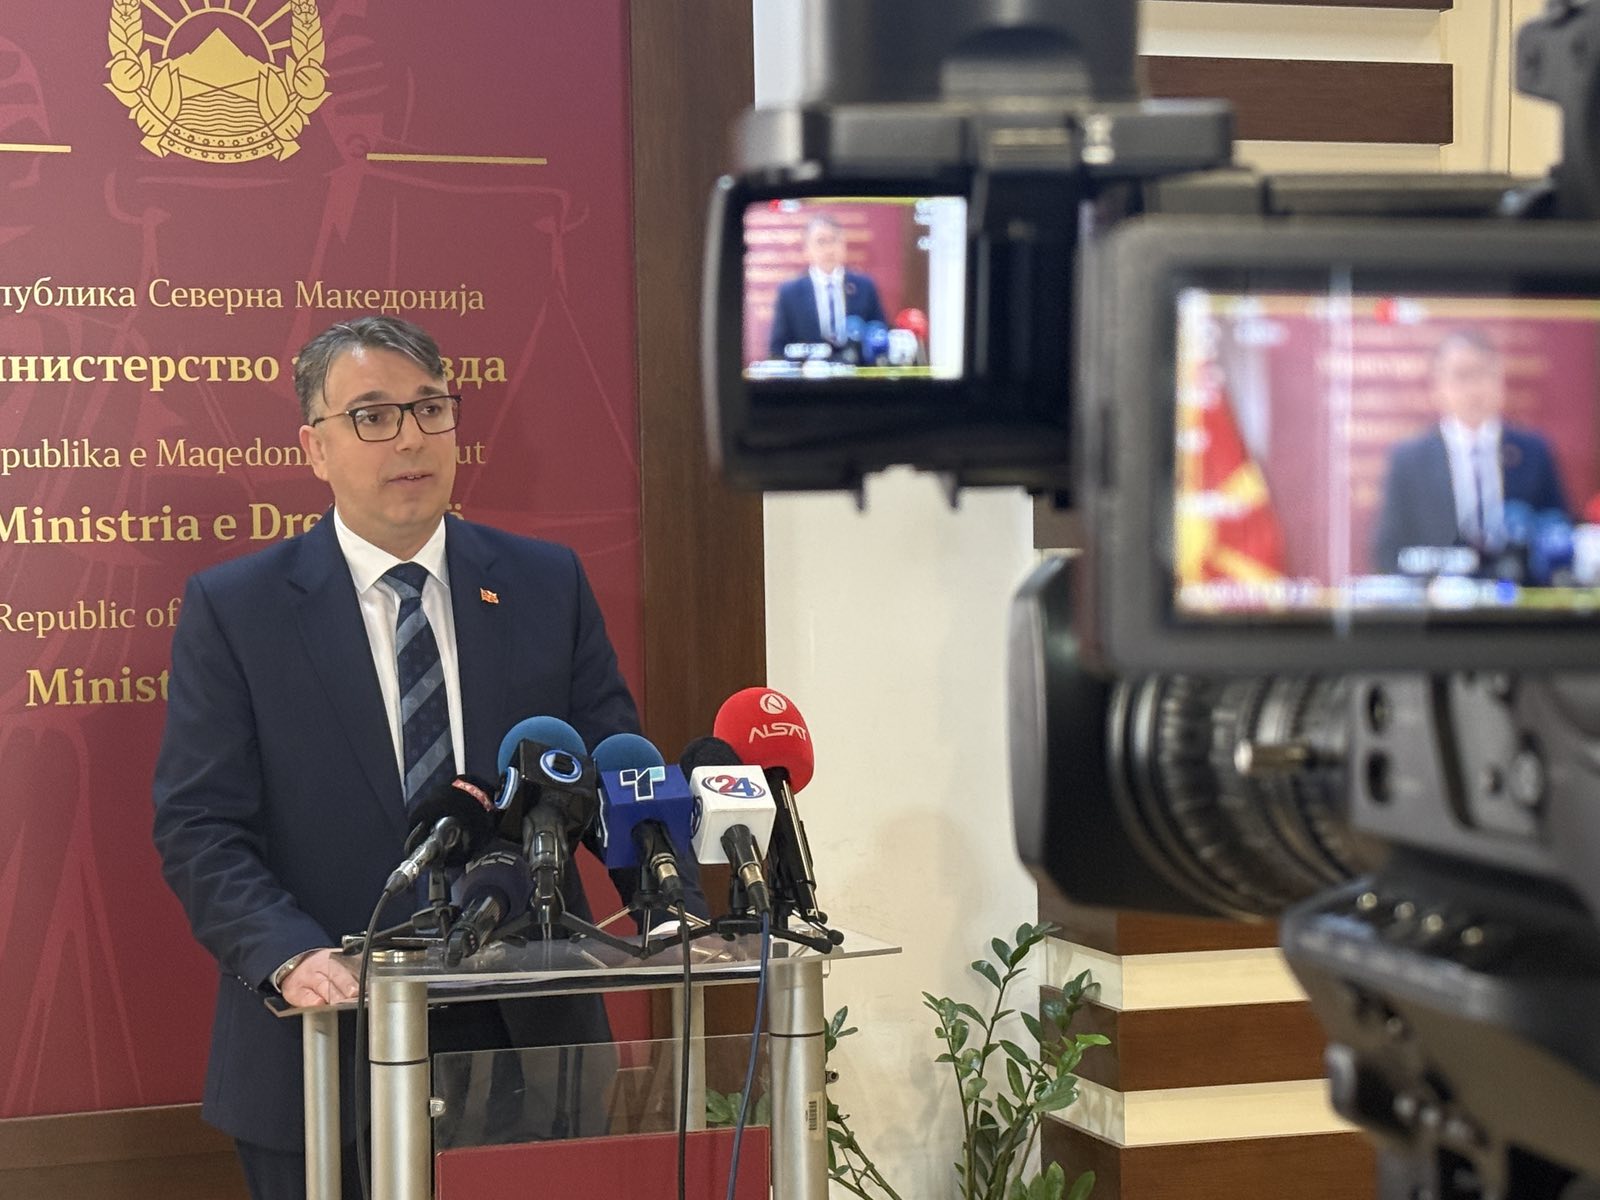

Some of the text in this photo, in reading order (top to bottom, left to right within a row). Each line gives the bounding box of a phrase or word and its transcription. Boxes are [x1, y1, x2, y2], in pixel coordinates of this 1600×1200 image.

[148, 278, 285, 316] Северна
[294, 280, 486, 317] Македонија
[0, 355, 280, 392] нистерство
[0, 438, 122, 476] publika
[129, 447, 148, 468] e
[0, 504, 202, 544] Ministria
[213, 514, 237, 541] e
[0, 597, 182, 638] Republic of
[25, 666, 169, 708] Minist
[714, 774, 757, 797] 24
